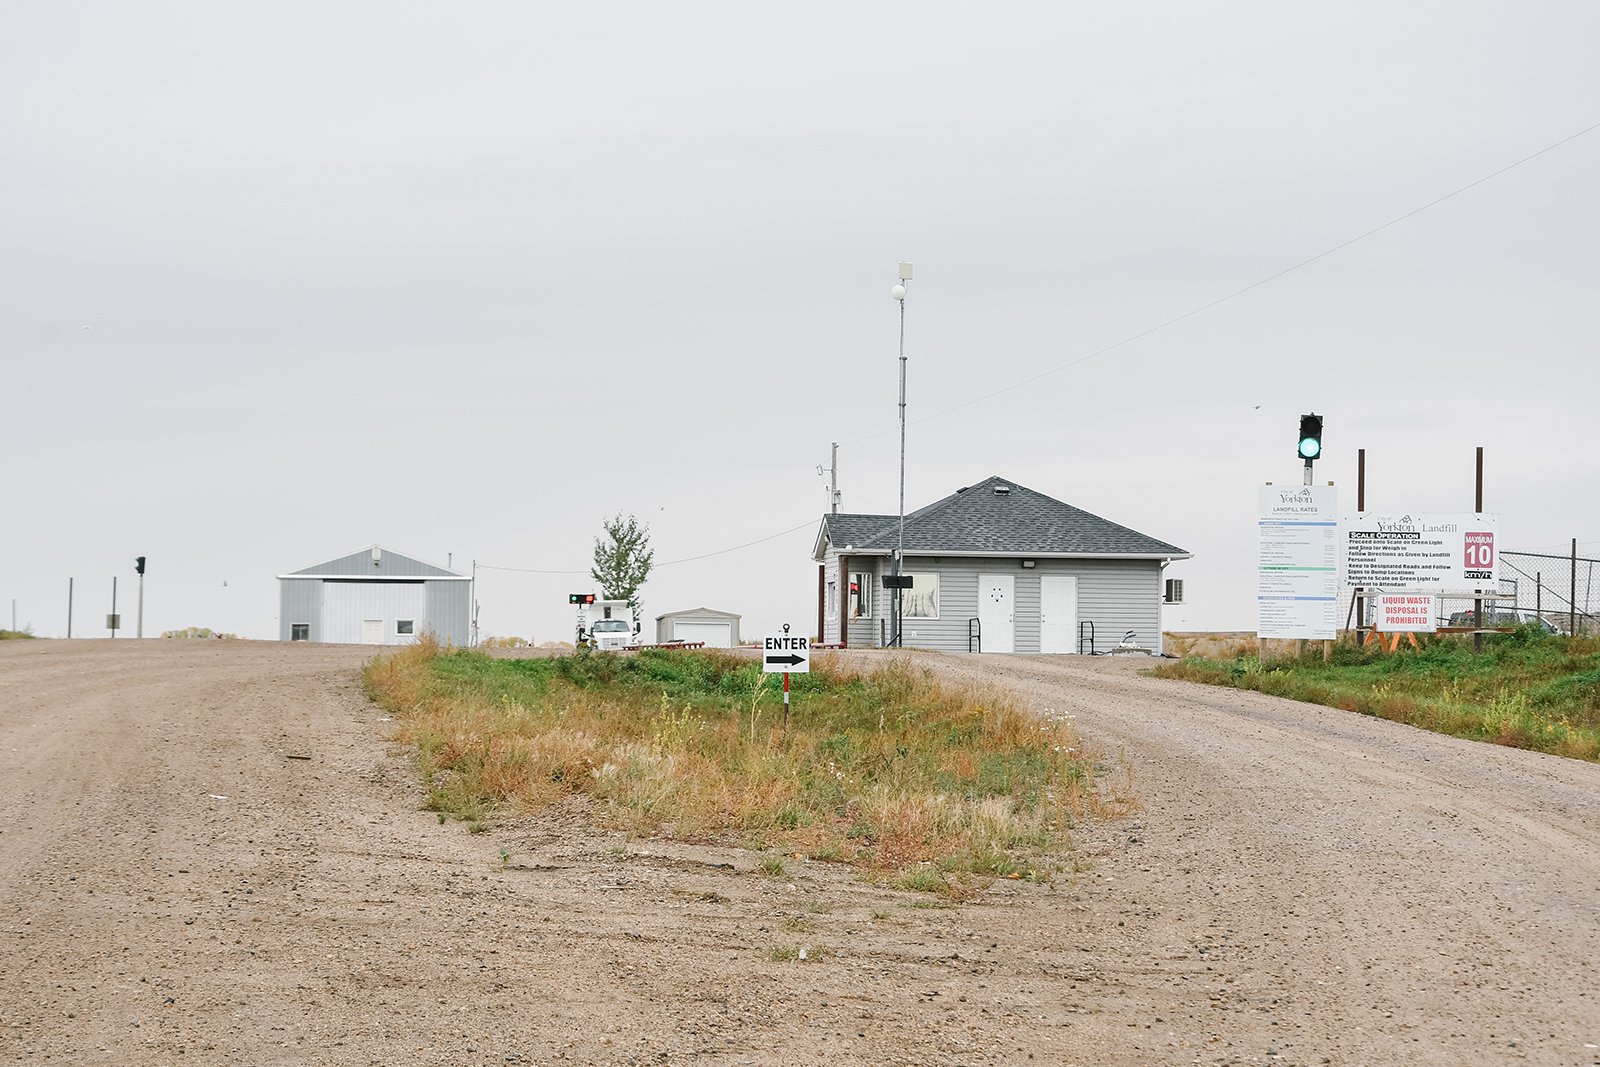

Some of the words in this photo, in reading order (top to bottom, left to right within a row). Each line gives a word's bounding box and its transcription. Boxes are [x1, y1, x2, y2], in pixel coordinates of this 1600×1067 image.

[1280, 494, 1312, 503] Yorkton
[1378, 522, 1415, 532] Yorkton
[1422, 524, 1457, 532] Landfill
[1466, 545, 1491, 565] 10
[766, 638, 807, 649] ENTER
